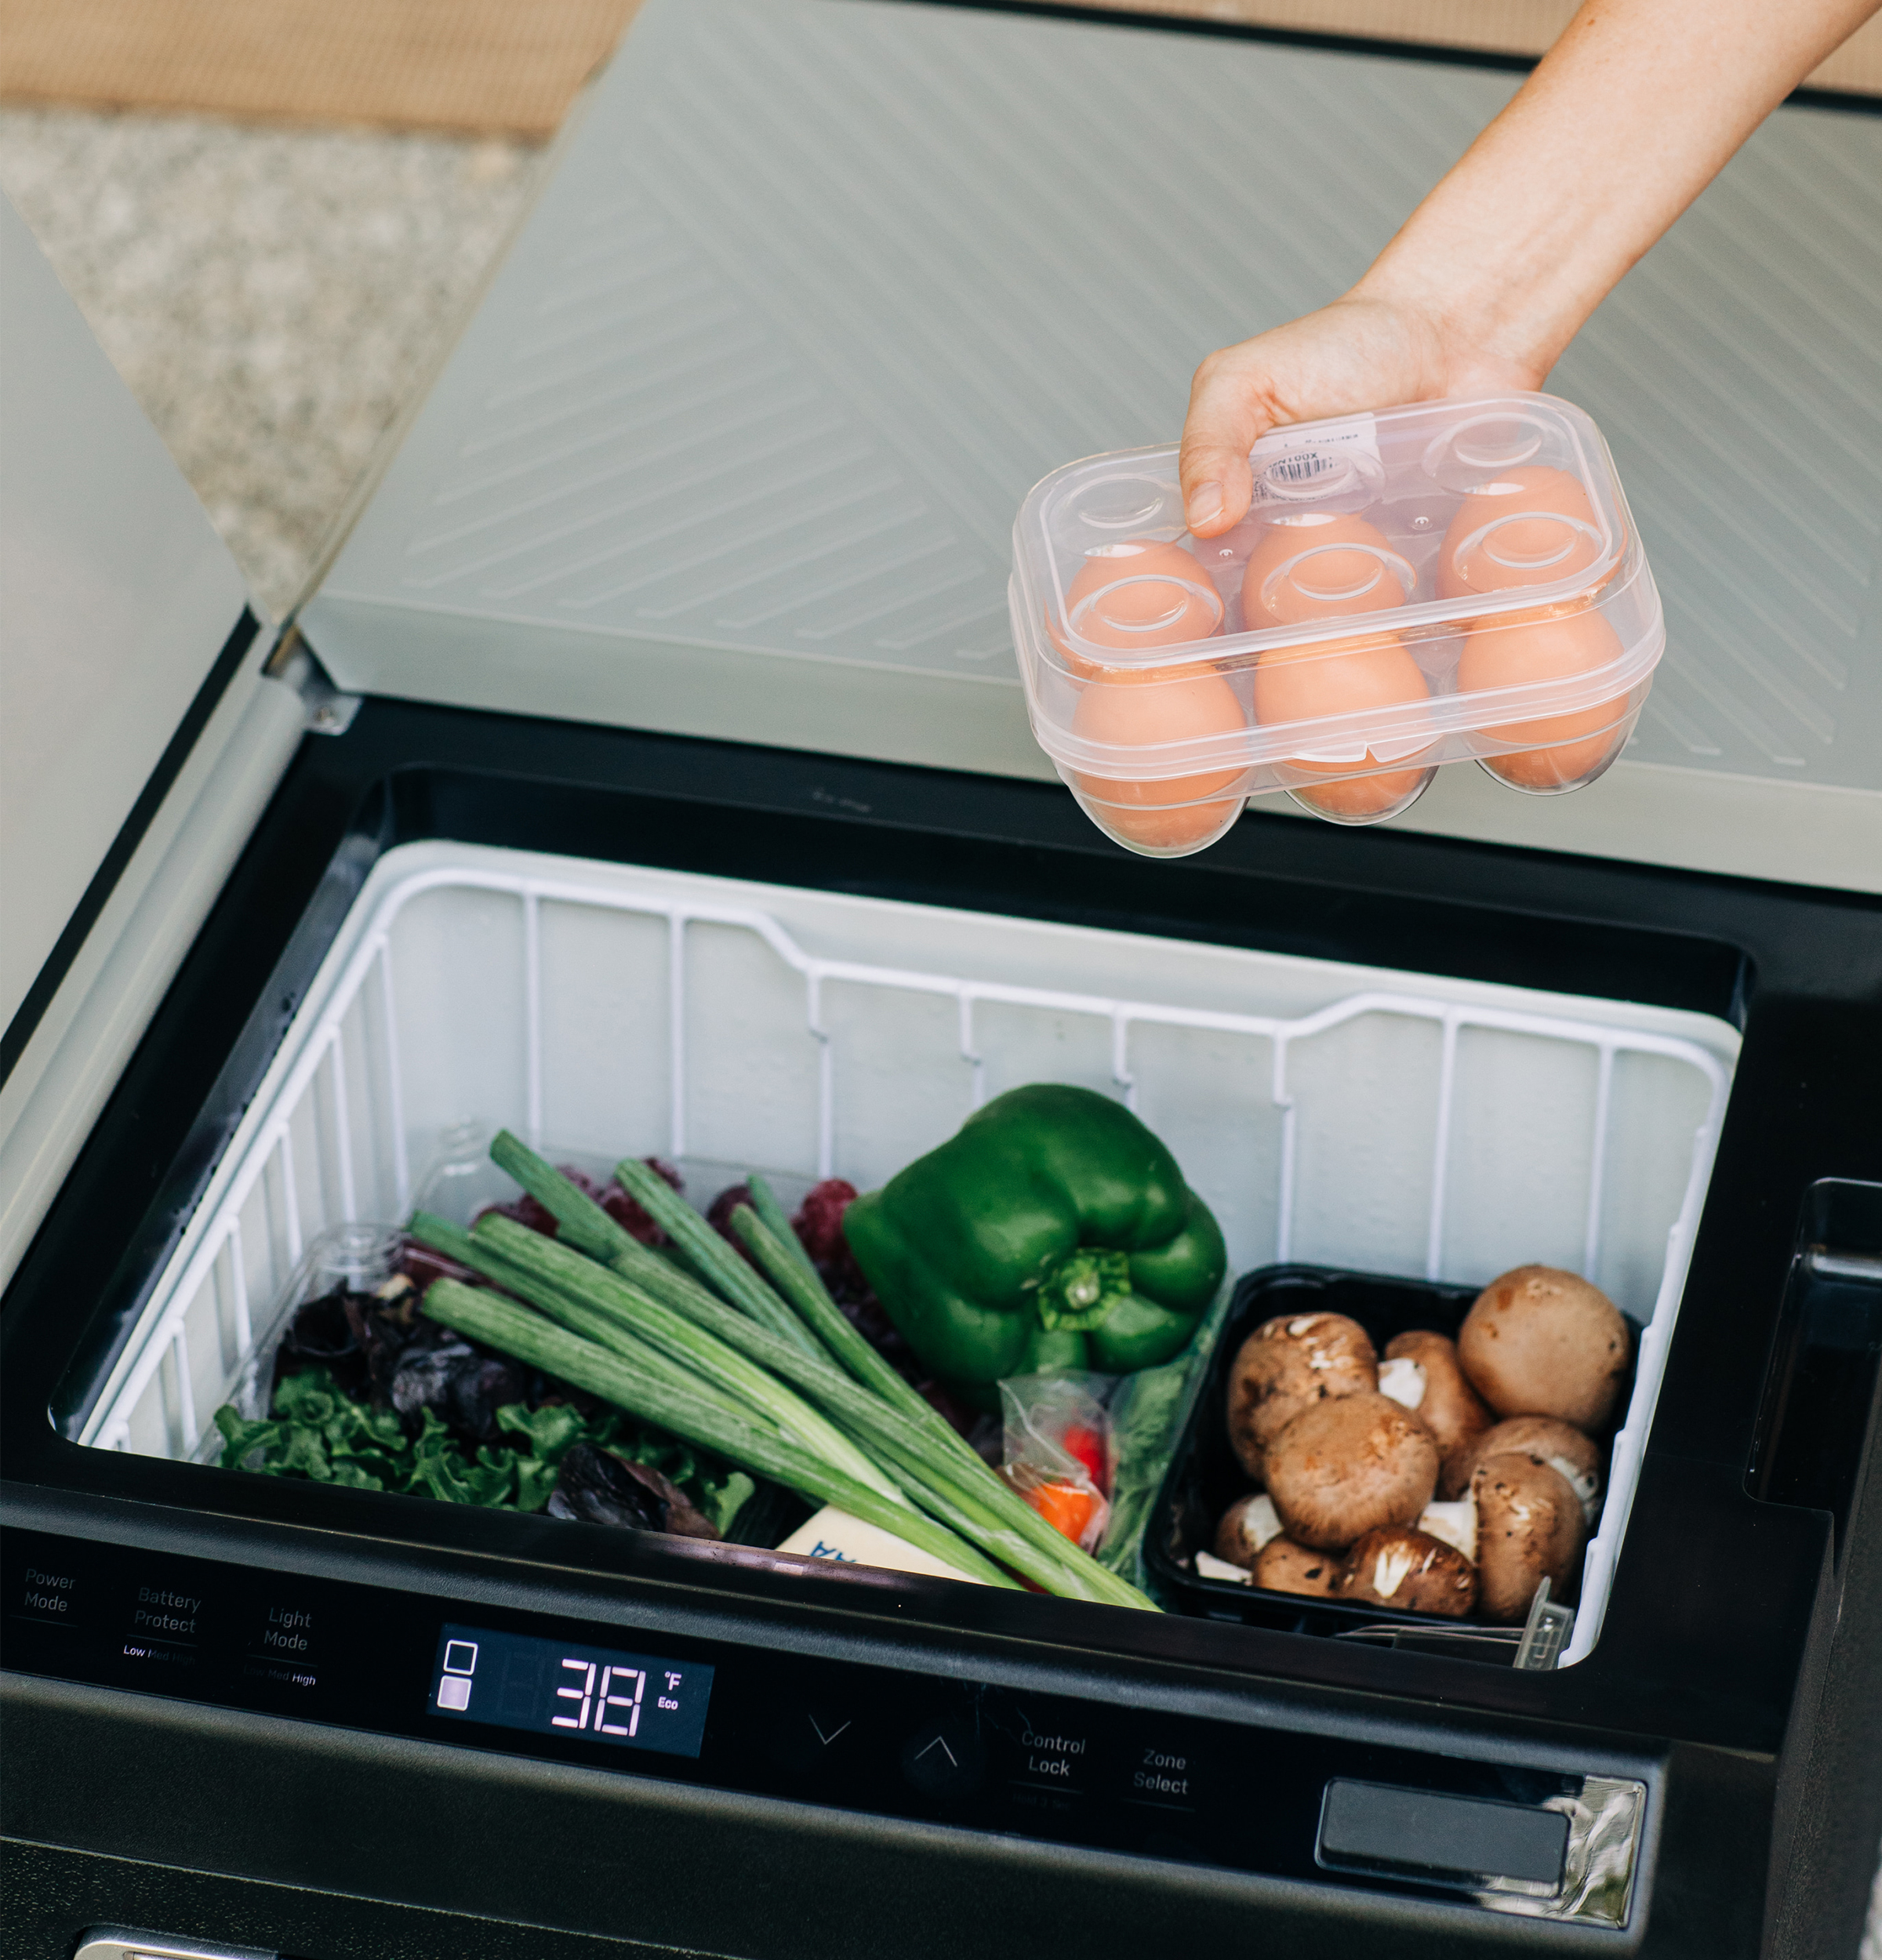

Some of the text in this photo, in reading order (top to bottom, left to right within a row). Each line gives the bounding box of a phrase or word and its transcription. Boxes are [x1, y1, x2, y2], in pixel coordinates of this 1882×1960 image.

[25, 1569, 75, 1589] Power
[24, 1592, 67, 1612] Mode
[138, 1587, 201, 1613] Battery
[134, 1610, 196, 1633] Protect
[269, 1607, 311, 1628] Light
[264, 1630, 307, 1650] Mode
[123, 1645, 145, 1657] Low
[292, 1672, 316, 1686] High
[551, 1658, 646, 1737] 38
[657, 1697, 678, 1710] Eco
[1022, 1732, 1085, 1755] Control
[1029, 1755, 1070, 1777] Lock
[1143, 1748, 1186, 1770] Zone
[1134, 1772, 1188, 1795] Select
